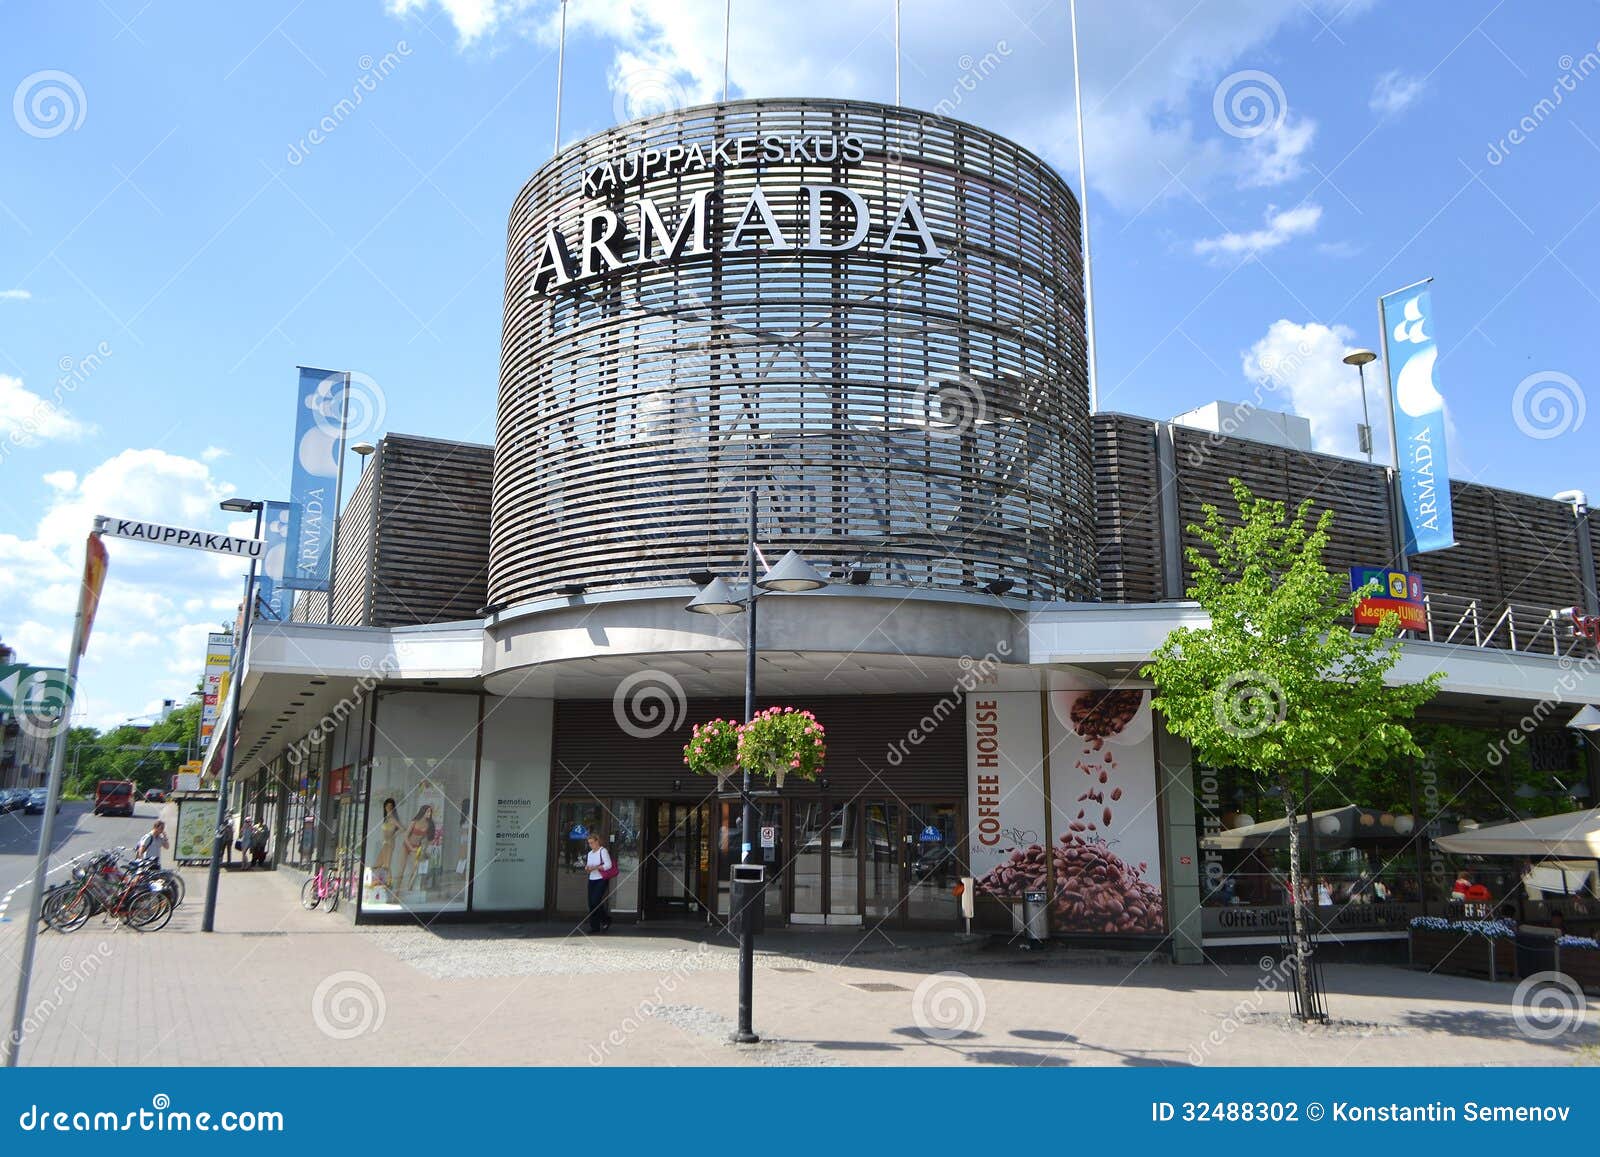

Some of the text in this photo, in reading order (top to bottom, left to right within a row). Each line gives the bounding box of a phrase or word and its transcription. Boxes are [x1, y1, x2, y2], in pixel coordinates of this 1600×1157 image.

[581, 135, 865, 196] KAUPPAKESKUS
[526, 183, 950, 297] ARMADA
[1415, 426, 1438, 531] ARMADA
[116, 520, 263, 556] KAUPPAKATU
[303, 488, 324, 576] ARMADA
[975, 699, 999, 768] HOUSE
[977, 774, 1001, 846] COFFEE
[1218, 910, 1257, 928] COFFEE
